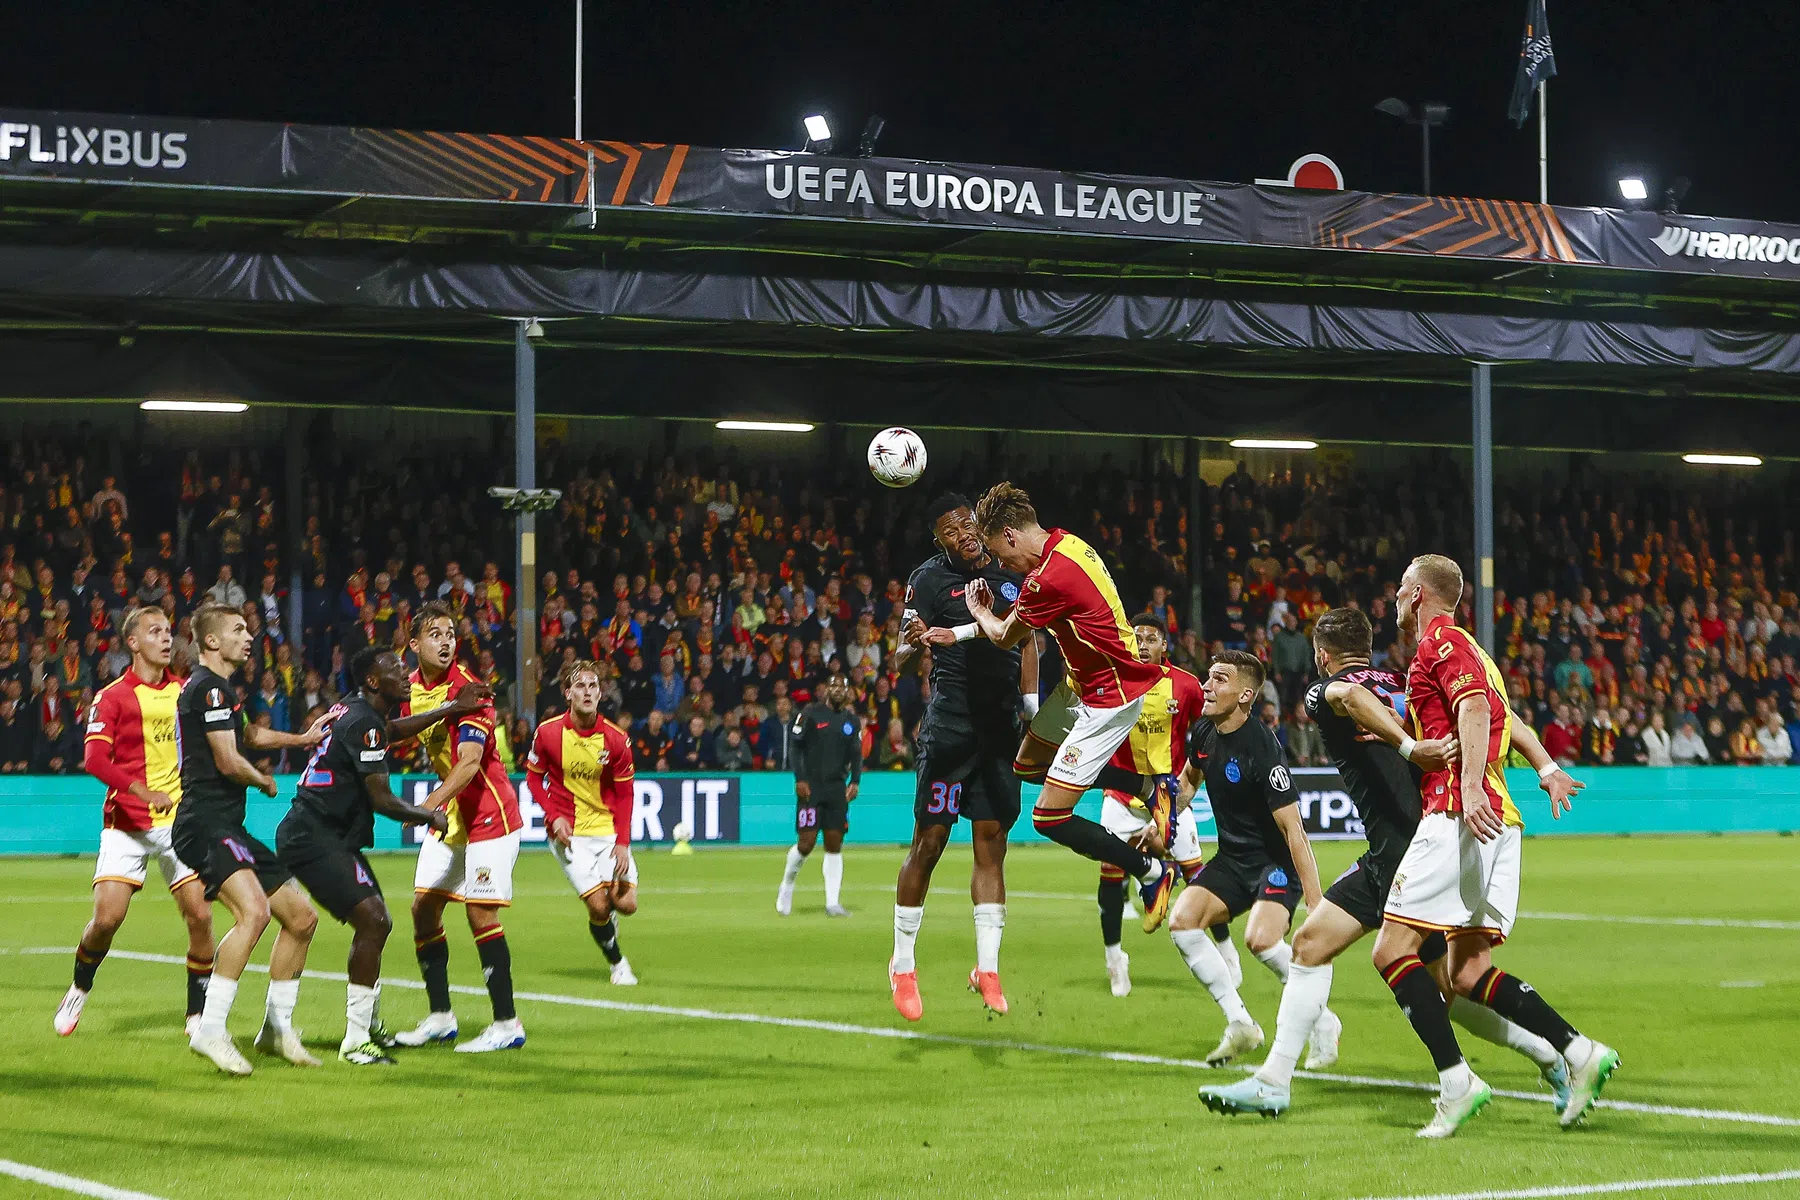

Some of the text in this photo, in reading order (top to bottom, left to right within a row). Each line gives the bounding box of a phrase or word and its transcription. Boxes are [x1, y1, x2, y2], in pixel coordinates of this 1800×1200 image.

[765, 163, 875, 205] UEFA
[886, 171, 1045, 216] EUROPA
[1054, 182, 1205, 226] LEAGUE
[1270, 766, 1291, 792] MG
